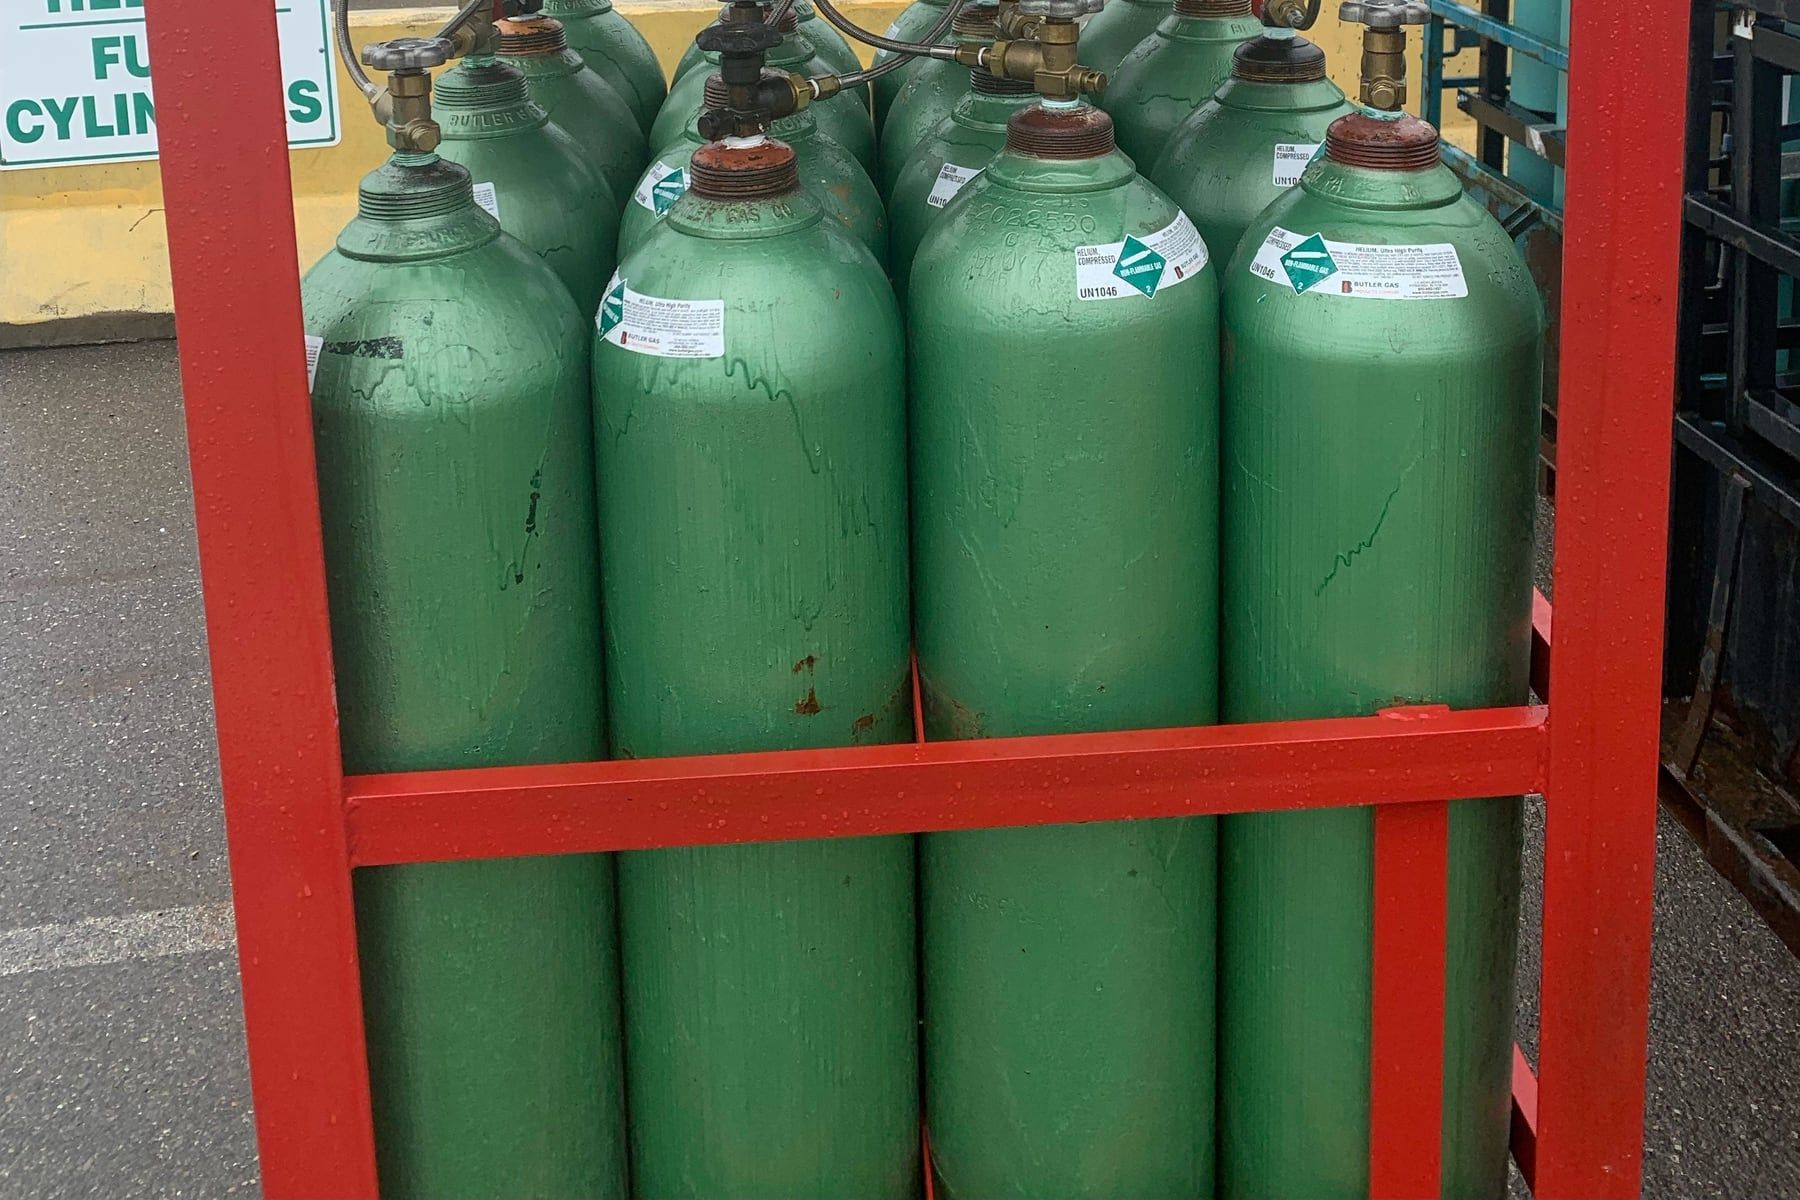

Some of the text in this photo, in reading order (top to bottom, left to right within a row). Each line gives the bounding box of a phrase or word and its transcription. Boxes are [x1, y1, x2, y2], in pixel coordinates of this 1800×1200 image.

[91, 35, 151, 80] FU
[6, 79, 323, 144] CYLINS
[1276, 152, 1310, 160] COMPRESSED
[1078, 255, 1116, 266] COMPRESSED
[1120, 261, 1162, 278] NON-FLAMMABLE GAS
[1251, 262, 1276, 279] UN1046
[1285, 259, 1319, 273] NON-FLAMMABLE
[1319, 266, 1330, 275] GAS
[1145, 285, 1152, 293] 2
[1297, 282, 1304, 290] 2
[1080, 287, 1118, 299] UN1046
[628, 333, 648, 342] BUTLER
